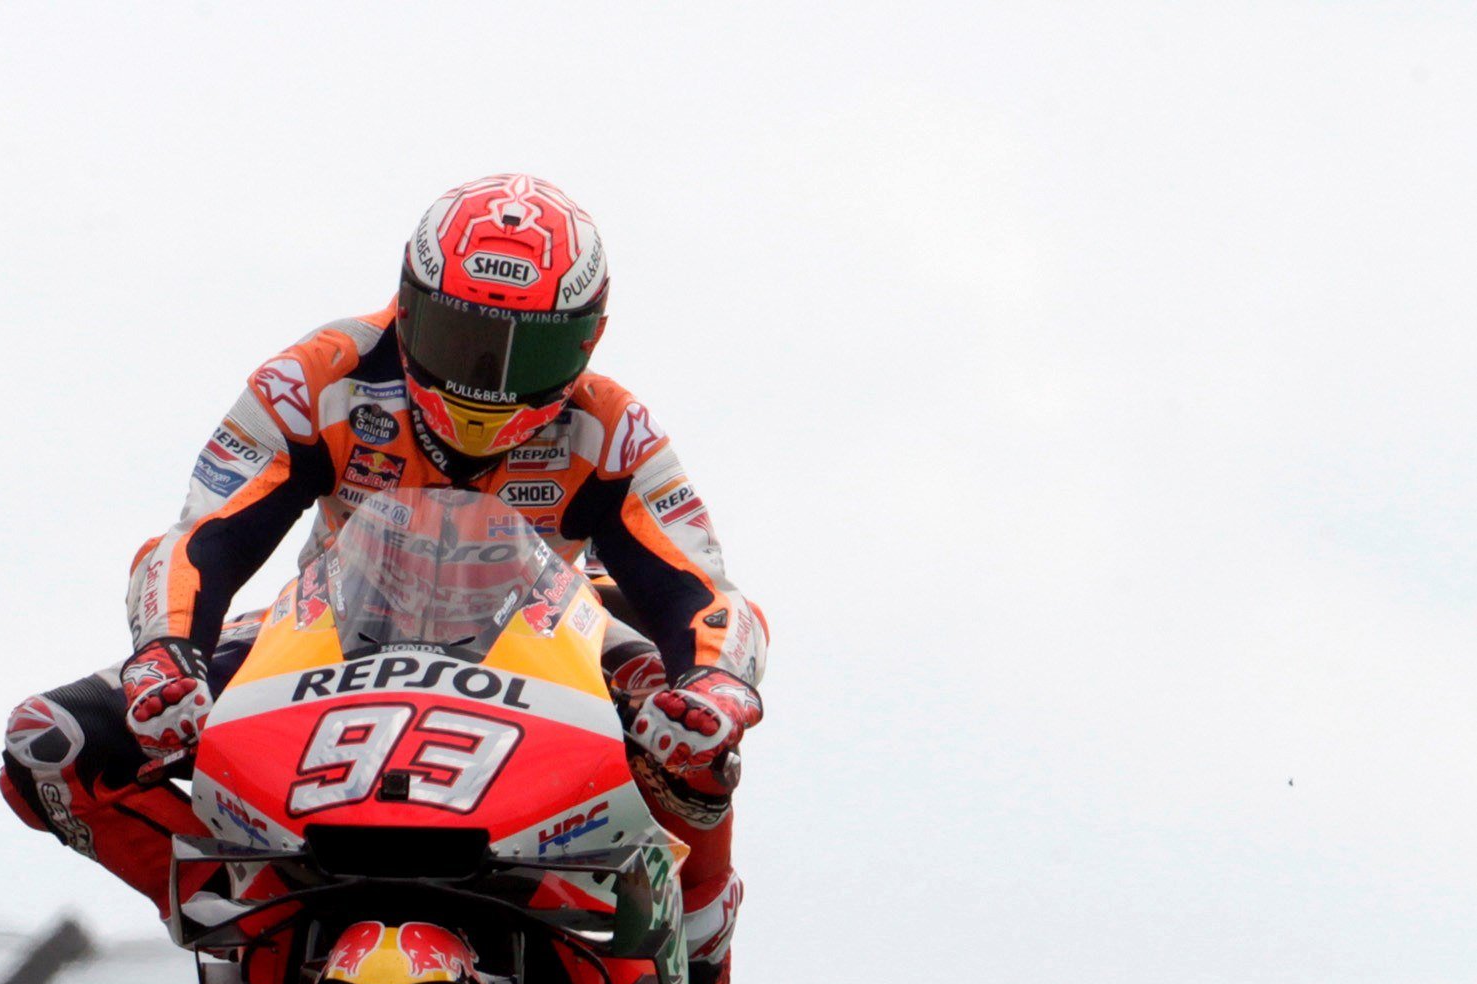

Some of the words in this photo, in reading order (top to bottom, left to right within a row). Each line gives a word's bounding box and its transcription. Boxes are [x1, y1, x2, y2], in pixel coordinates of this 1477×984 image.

[473, 257, 529, 281] SHOEI
[431, 291, 469, 312] GIVES
[479, 305, 512, 319] YOU
[521, 312, 569, 324] WINGS
[446, 380, 517, 403] PULL&BEAR
[356, 408, 394, 428] Estrella
[356, 420, 390, 439] Galicia
[412, 409, 448, 471] REPSOL
[510, 448, 567, 460] REPSOL
[338, 488, 390, 513] Allianz
[507, 485, 554, 502] SHOEI
[535, 540, 550, 567] 93
[492, 591, 518, 627] Puig
[380, 643, 446, 655] HONDA
[292, 657, 530, 710] REPSOL
[285, 701, 526, 820] 93
[215, 789, 271, 848] HRC
[538, 800, 609, 856] HRC
